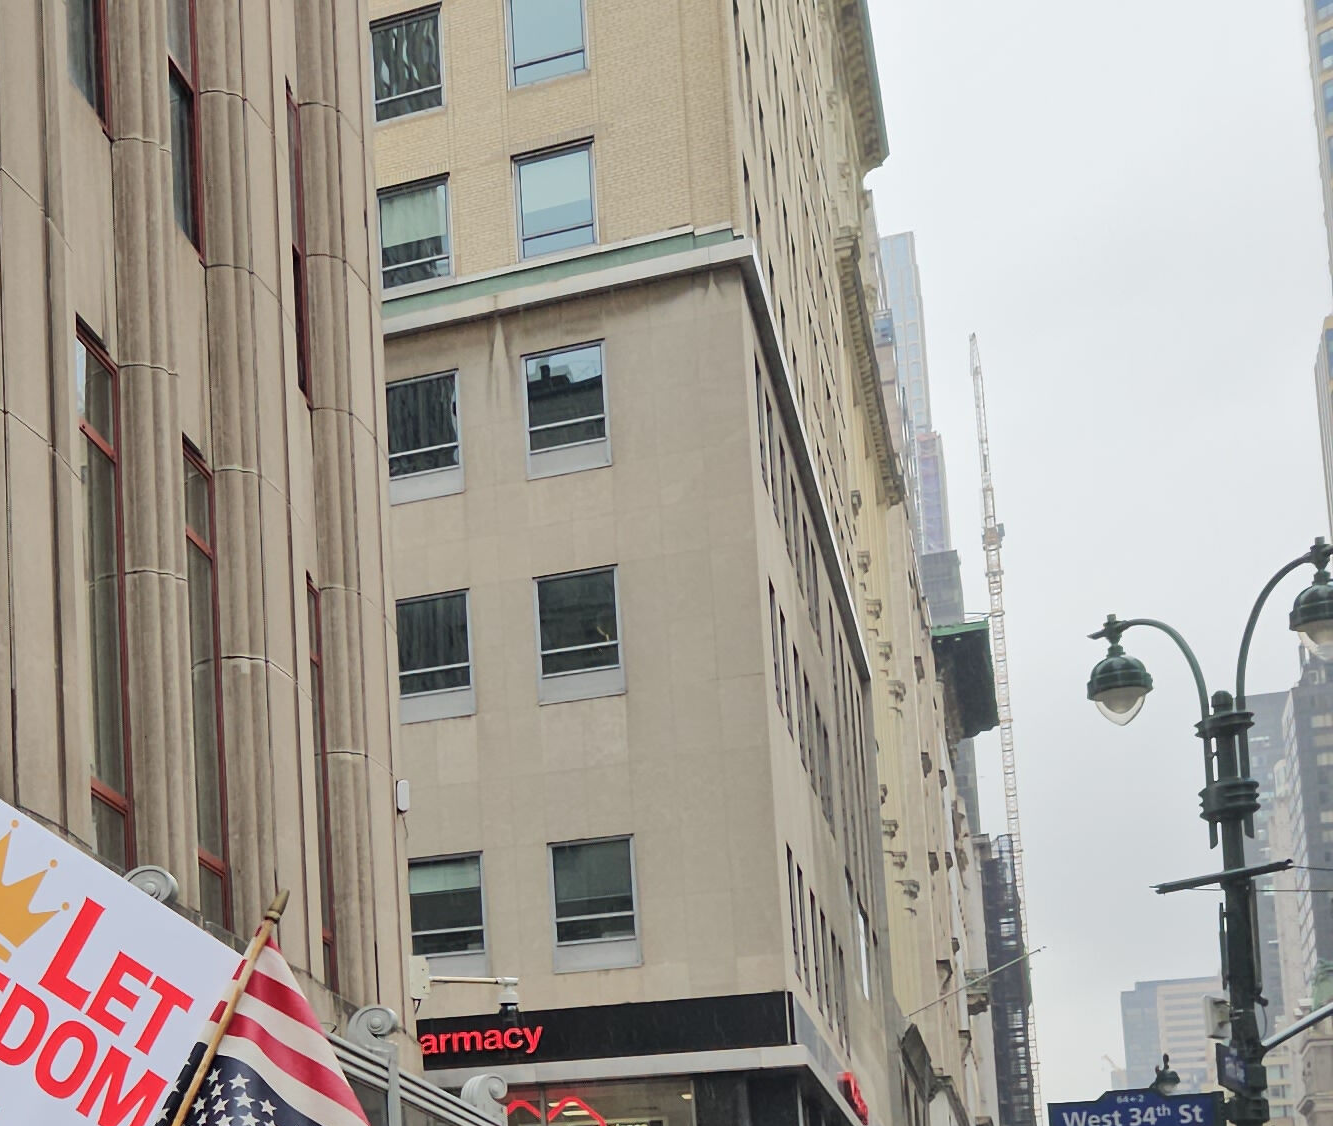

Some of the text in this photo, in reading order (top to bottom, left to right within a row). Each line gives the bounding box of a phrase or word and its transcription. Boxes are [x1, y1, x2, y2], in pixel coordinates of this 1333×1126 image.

[37, 896, 195, 1056] LET
[1129, 1104, 1172, 1126] 34th
[1178, 1104, 1204, 1125] St
